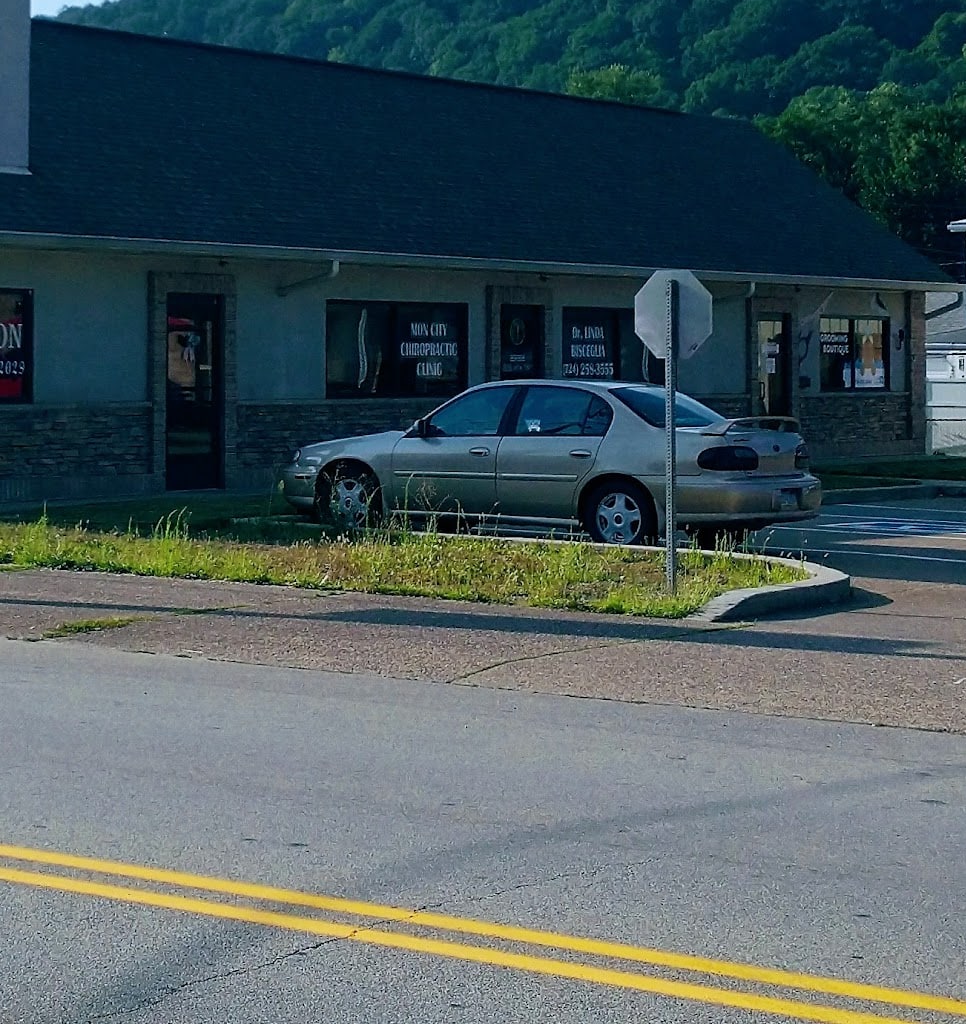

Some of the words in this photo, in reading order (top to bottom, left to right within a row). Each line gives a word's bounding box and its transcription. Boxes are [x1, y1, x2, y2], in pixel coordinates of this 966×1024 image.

[410, 322, 429, 337] MON
[430, 322, 448, 337] CITY
[584, 325, 605, 339] LINDA
[400, 342, 458, 356] CHIROPRACTIC
[823, 344, 849, 356] BOUTIQUE
[416, 362, 443, 376] CLINIC
